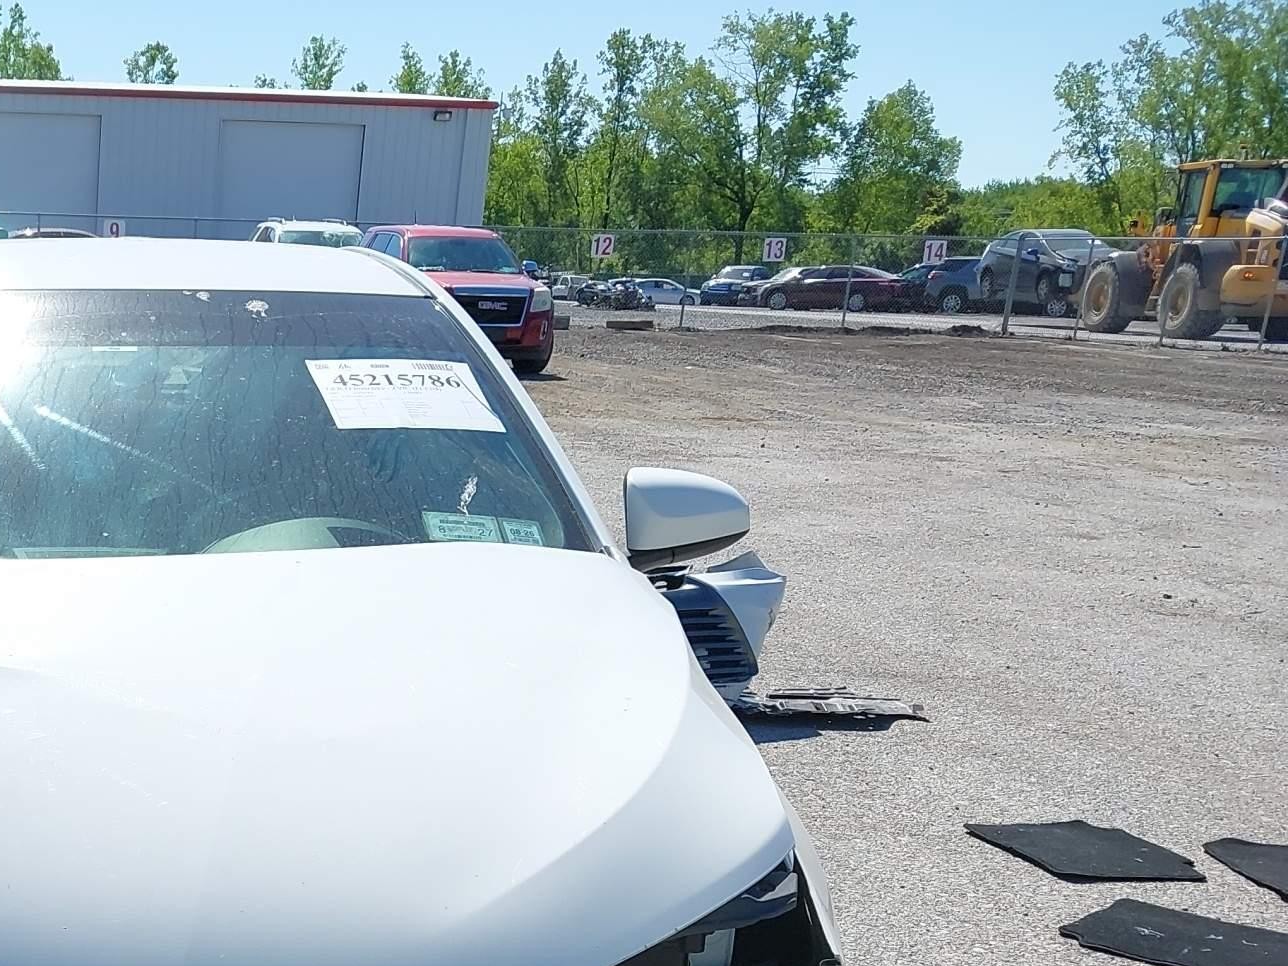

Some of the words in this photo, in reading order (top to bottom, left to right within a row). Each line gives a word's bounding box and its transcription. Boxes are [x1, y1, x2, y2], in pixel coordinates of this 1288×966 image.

[110, 222, 120, 238] 9
[594, 236, 613, 256] 12
[765, 239, 785, 259] 13
[925, 242, 945, 262] 14
[478, 300, 508, 311] GMC
[333, 373, 462, 389] 45215786
